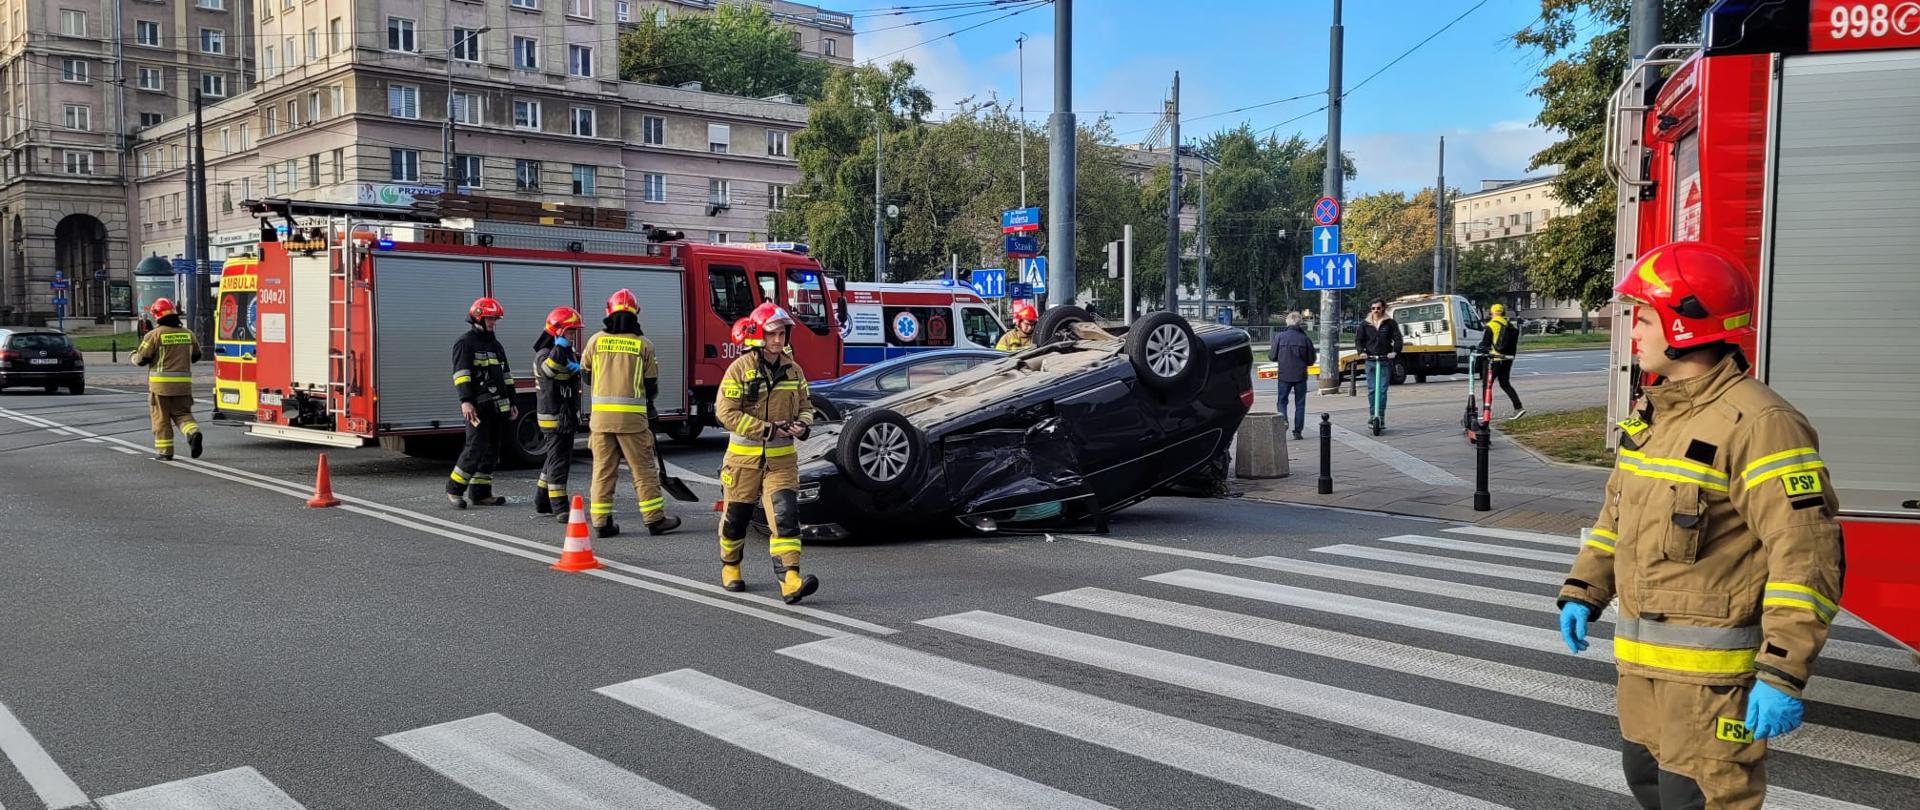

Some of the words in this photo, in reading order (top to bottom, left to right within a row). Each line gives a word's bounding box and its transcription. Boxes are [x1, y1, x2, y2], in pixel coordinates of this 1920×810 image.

[1831, 3, 1888, 39] 998
[1672, 319, 1685, 332] 4
[721, 342, 743, 359] 304
[1789, 475, 1815, 491] PSP
[1722, 721, 1751, 740] PSP
